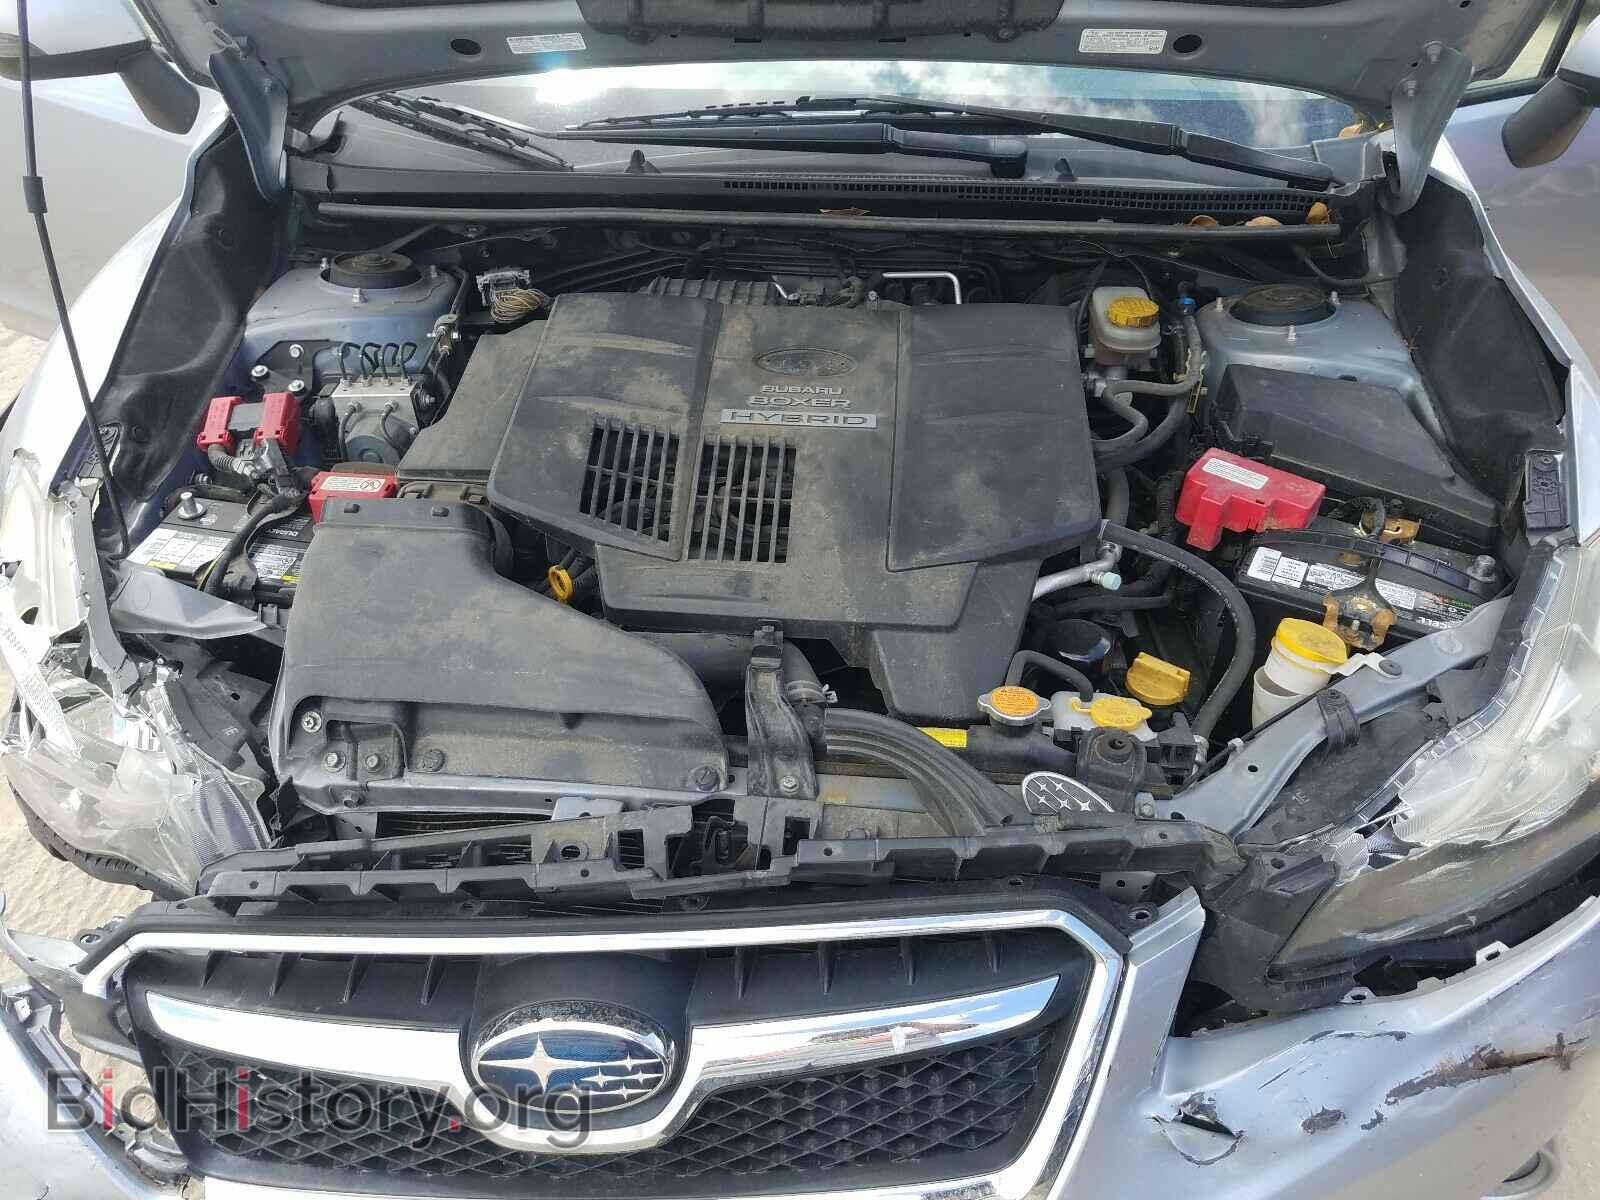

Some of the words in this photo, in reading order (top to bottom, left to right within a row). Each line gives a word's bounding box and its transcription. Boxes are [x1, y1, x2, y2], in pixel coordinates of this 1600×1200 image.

[760, 384, 843, 396] SUBARU
[748, 395, 851, 409] BOXER
[726, 411, 870, 427] HYBRID
